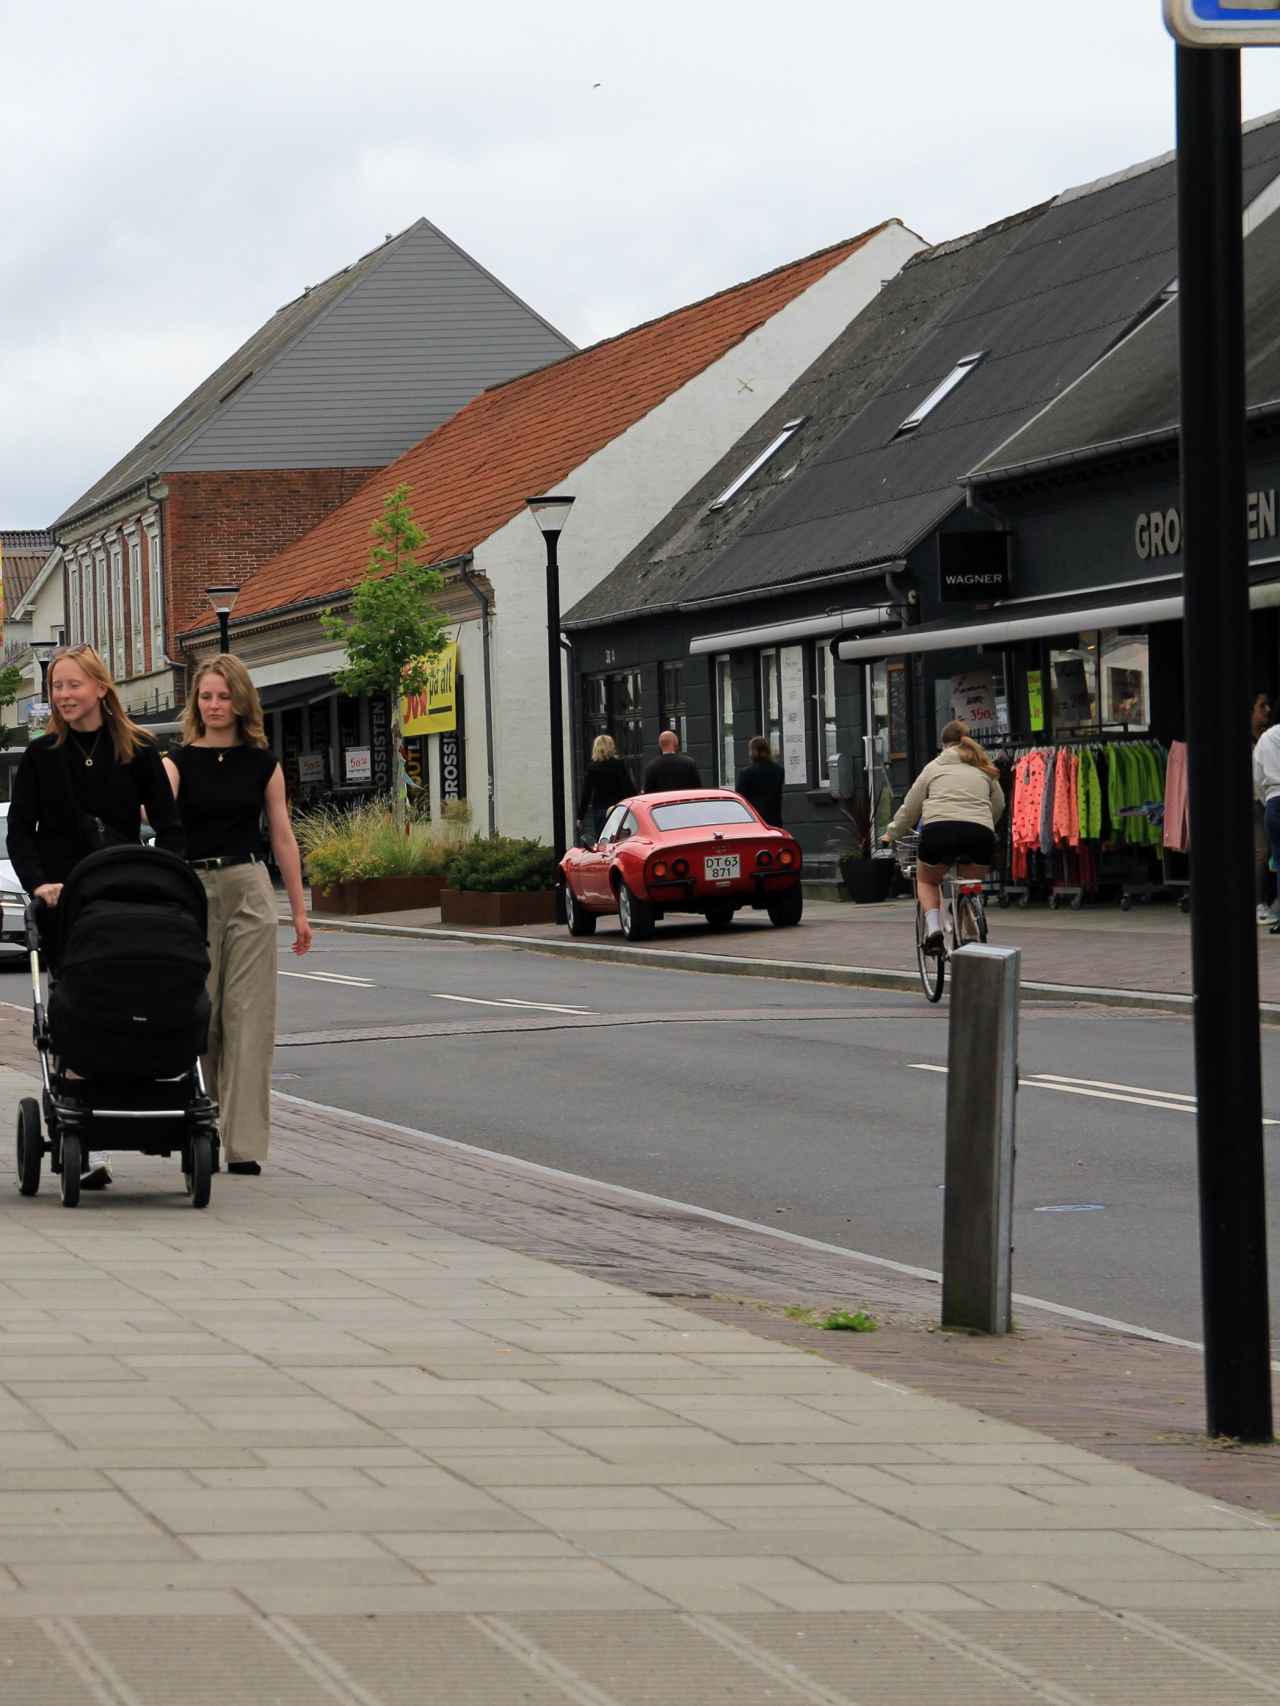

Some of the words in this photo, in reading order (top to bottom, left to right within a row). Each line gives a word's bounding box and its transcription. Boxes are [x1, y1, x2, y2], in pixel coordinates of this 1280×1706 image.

[945, 574, 1002, 585] WAGNER
[706, 857, 720, 869] DT
[724, 855, 738, 867] 63
[712, 867, 731, 879] 871
